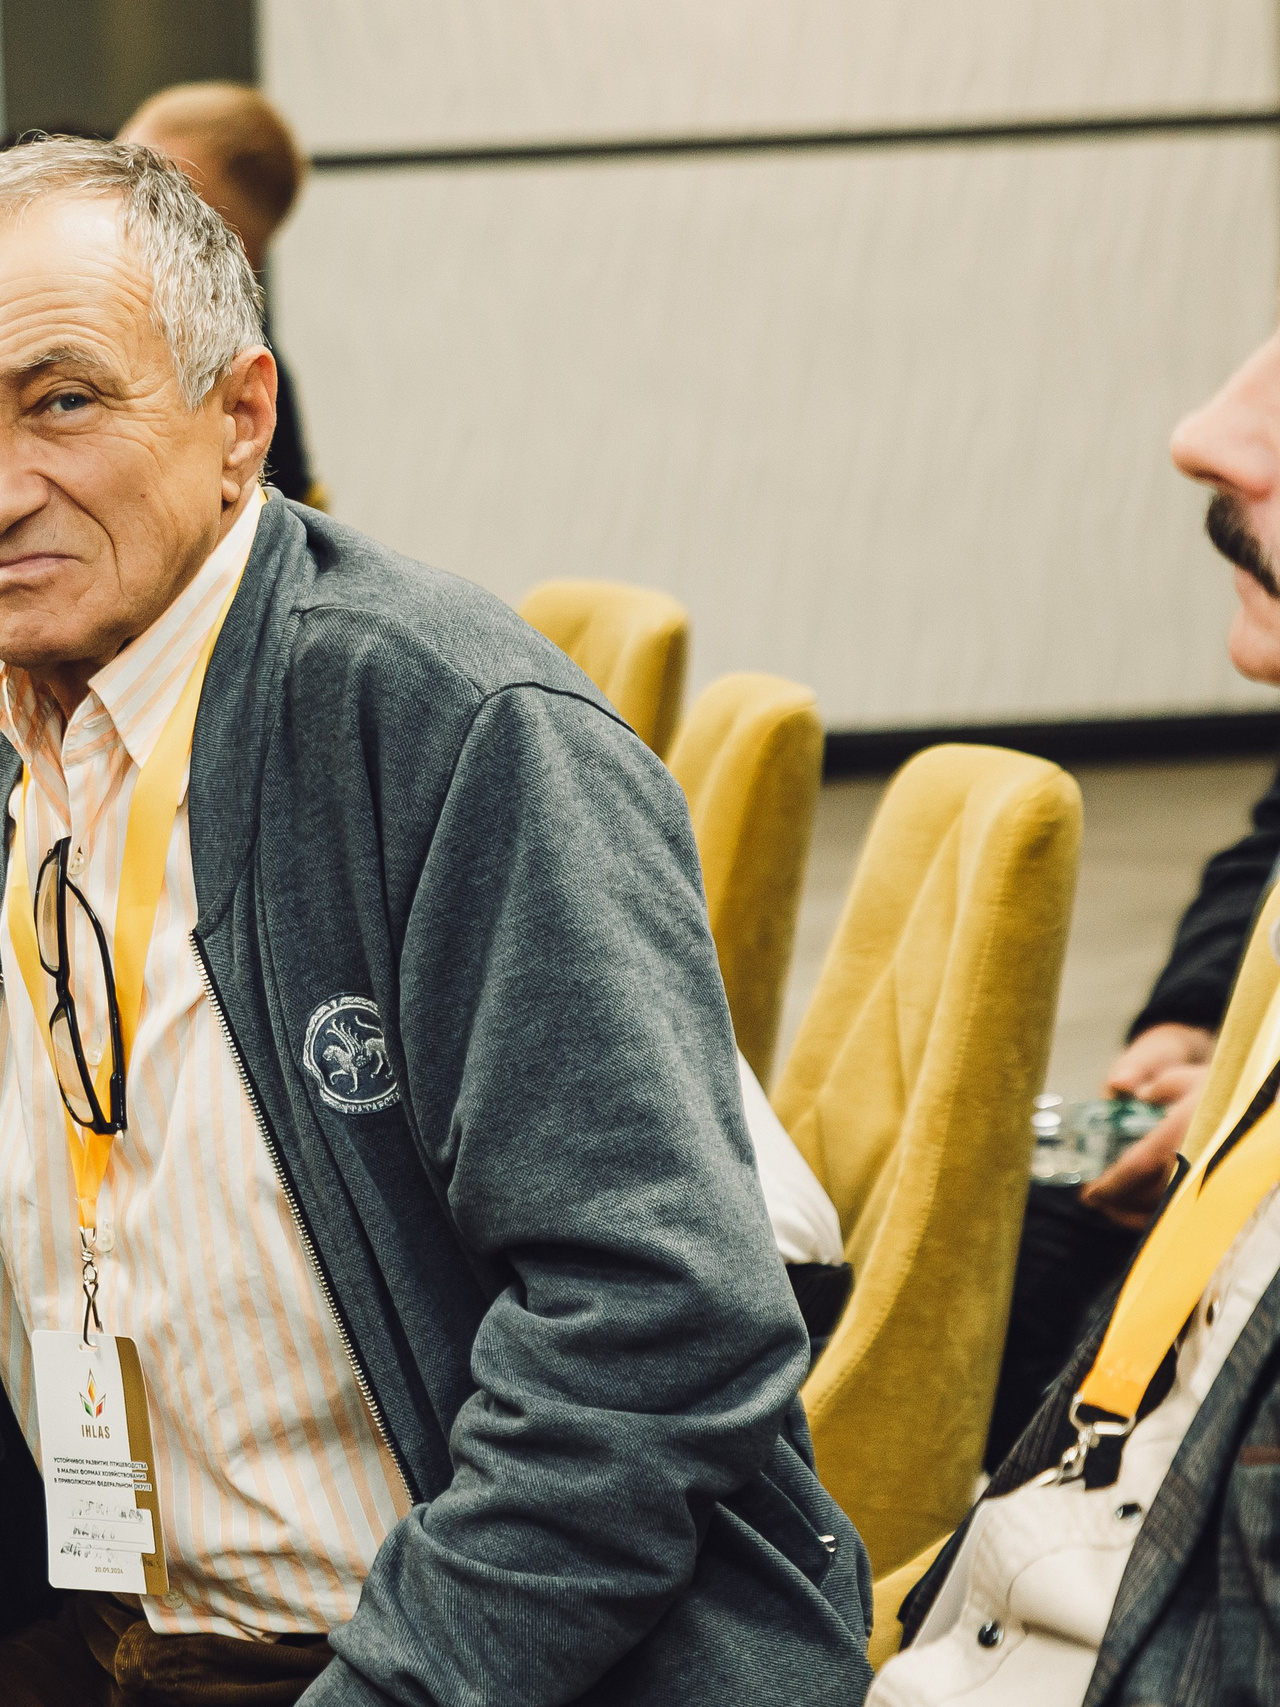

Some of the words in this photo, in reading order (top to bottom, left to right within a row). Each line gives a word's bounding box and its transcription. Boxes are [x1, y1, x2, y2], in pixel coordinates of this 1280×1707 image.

[81, 1424, 110, 1439] IHLAS
[53, 1457, 85, 1465] УСТОЙЧИВОЕ
[85, 1459, 109, 1467] РАЗВИТИЕ
[109, 1461, 147, 1469] ПТИЦЕВОДСТВА
[102, 1470, 146, 1479] ХОЗЯЙСТВОВАНИЯ
[97, 1480, 133, 1489] ФЕДЕРАЛЬНОМ
[94, 1566, 124, 1575] 20.09.2024
